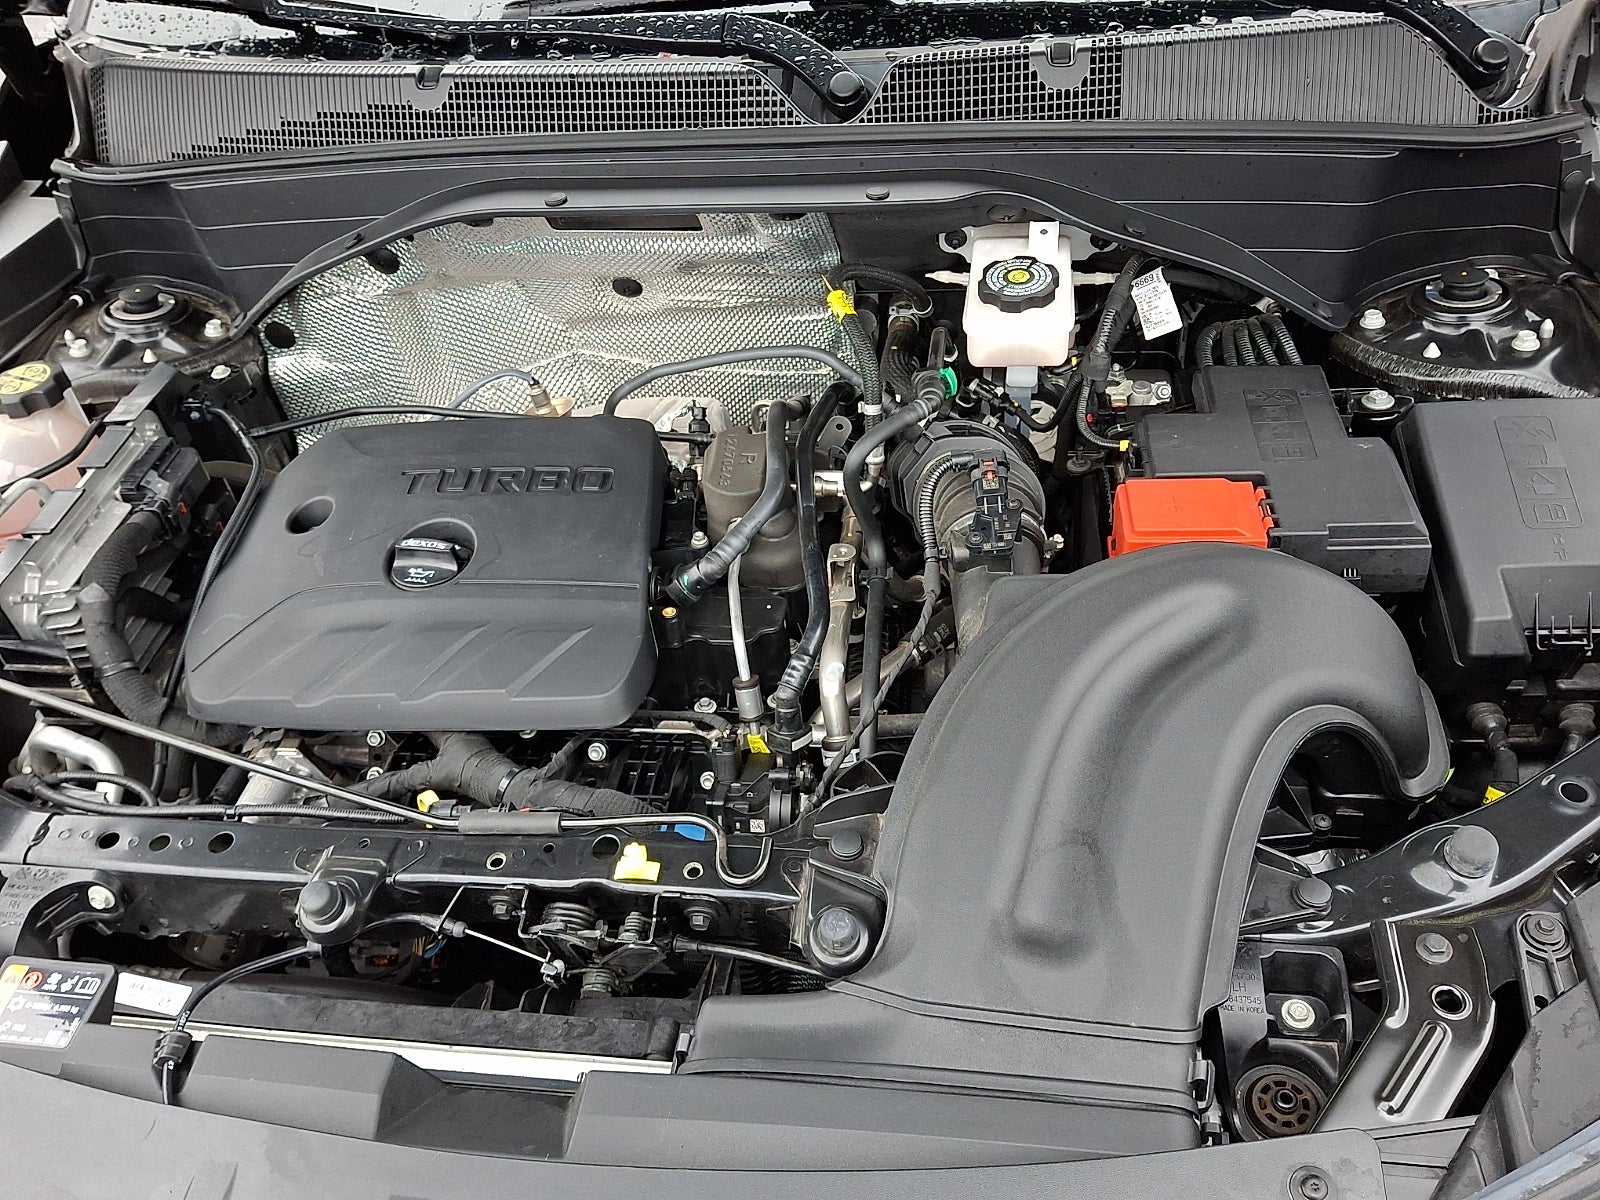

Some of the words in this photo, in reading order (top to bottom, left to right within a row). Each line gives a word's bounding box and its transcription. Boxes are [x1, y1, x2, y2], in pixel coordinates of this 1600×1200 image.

[1134, 273, 1155, 288] 6669
[401, 465, 615, 495] TURBO
[400, 538, 448, 549] dexos
[1232, 982, 1247, 992] LH
